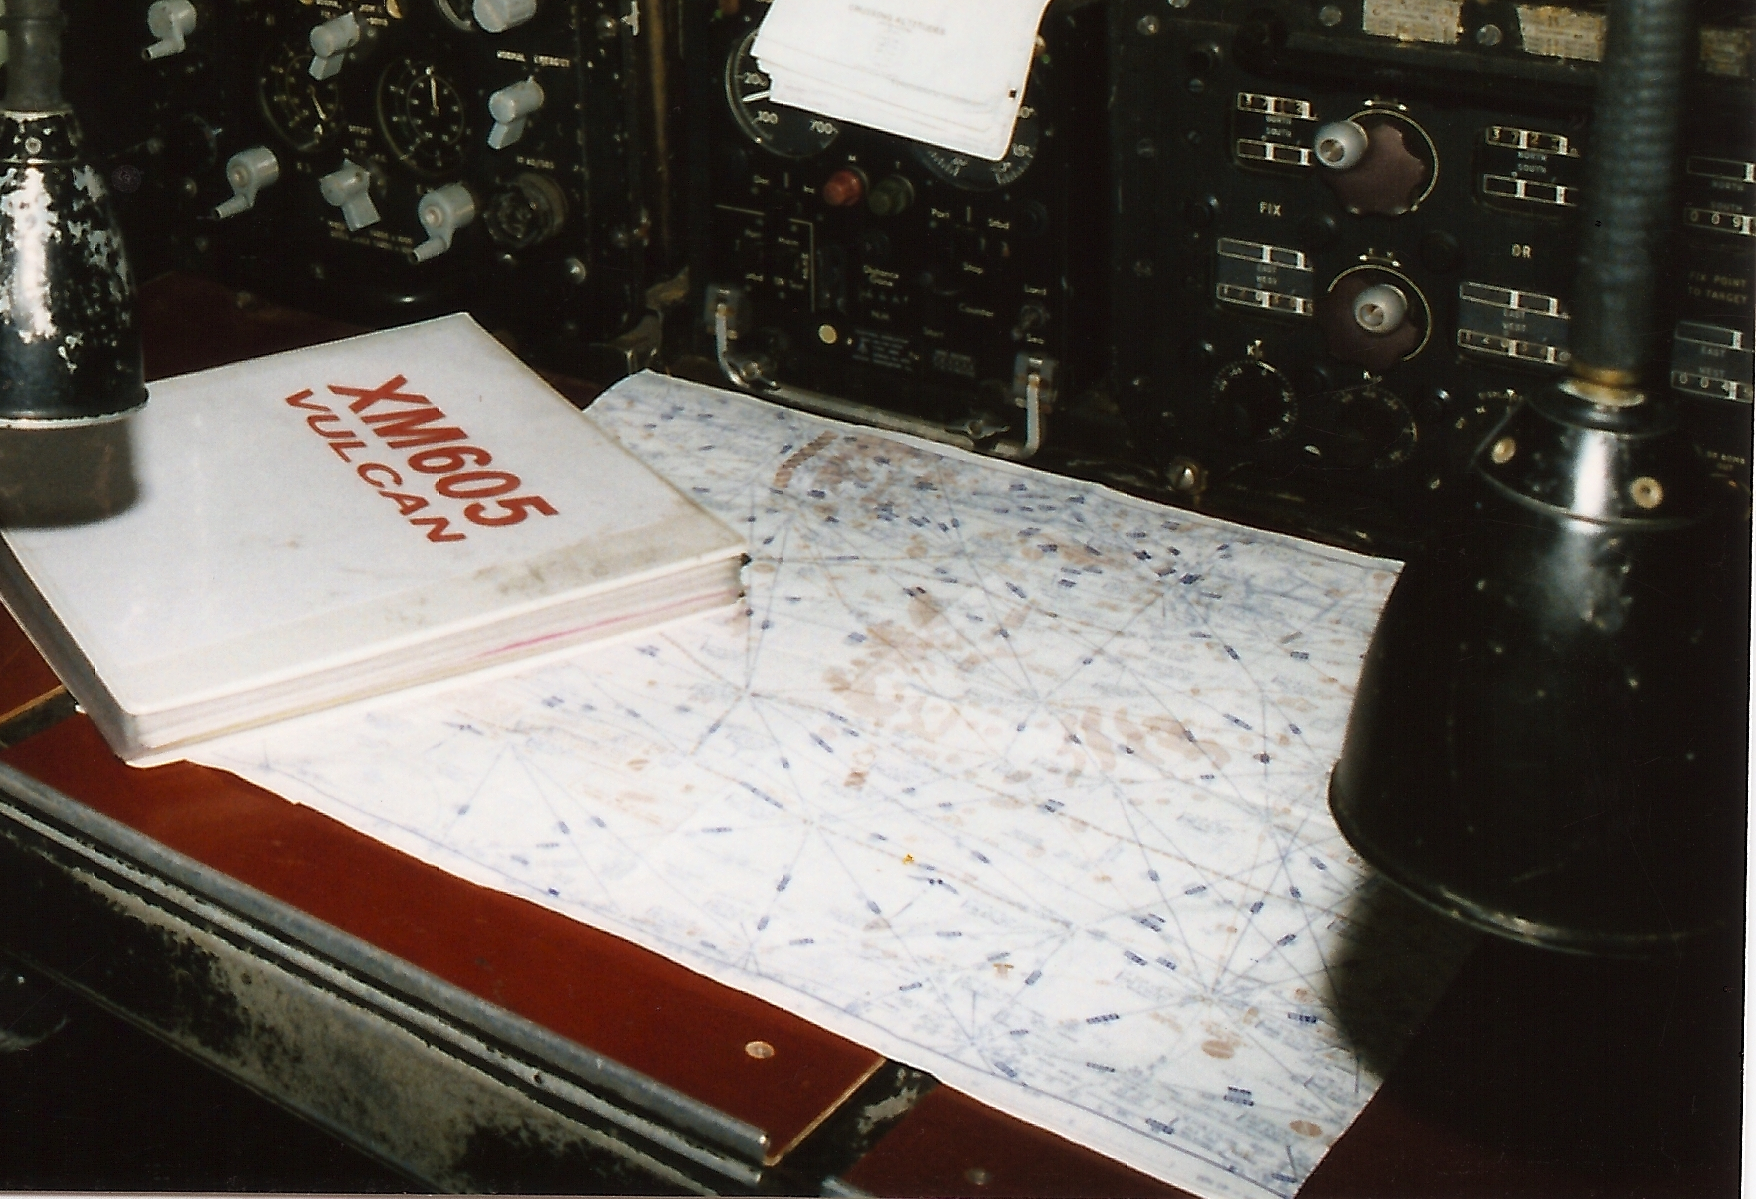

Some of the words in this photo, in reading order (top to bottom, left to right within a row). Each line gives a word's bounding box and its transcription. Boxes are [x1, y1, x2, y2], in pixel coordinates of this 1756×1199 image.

[1265, 126, 1293, 138] SOUTH
[1517, 163, 1547, 174] SOUTH
[1258, 200, 1283, 218] FIX
[1510, 243, 1533, 260] DR
[1713, 274, 1747, 288] POINT
[1704, 288, 1749, 304] TARGET
[327, 373, 560, 528] XM605
[284, 387, 468, 544] VULCAN
